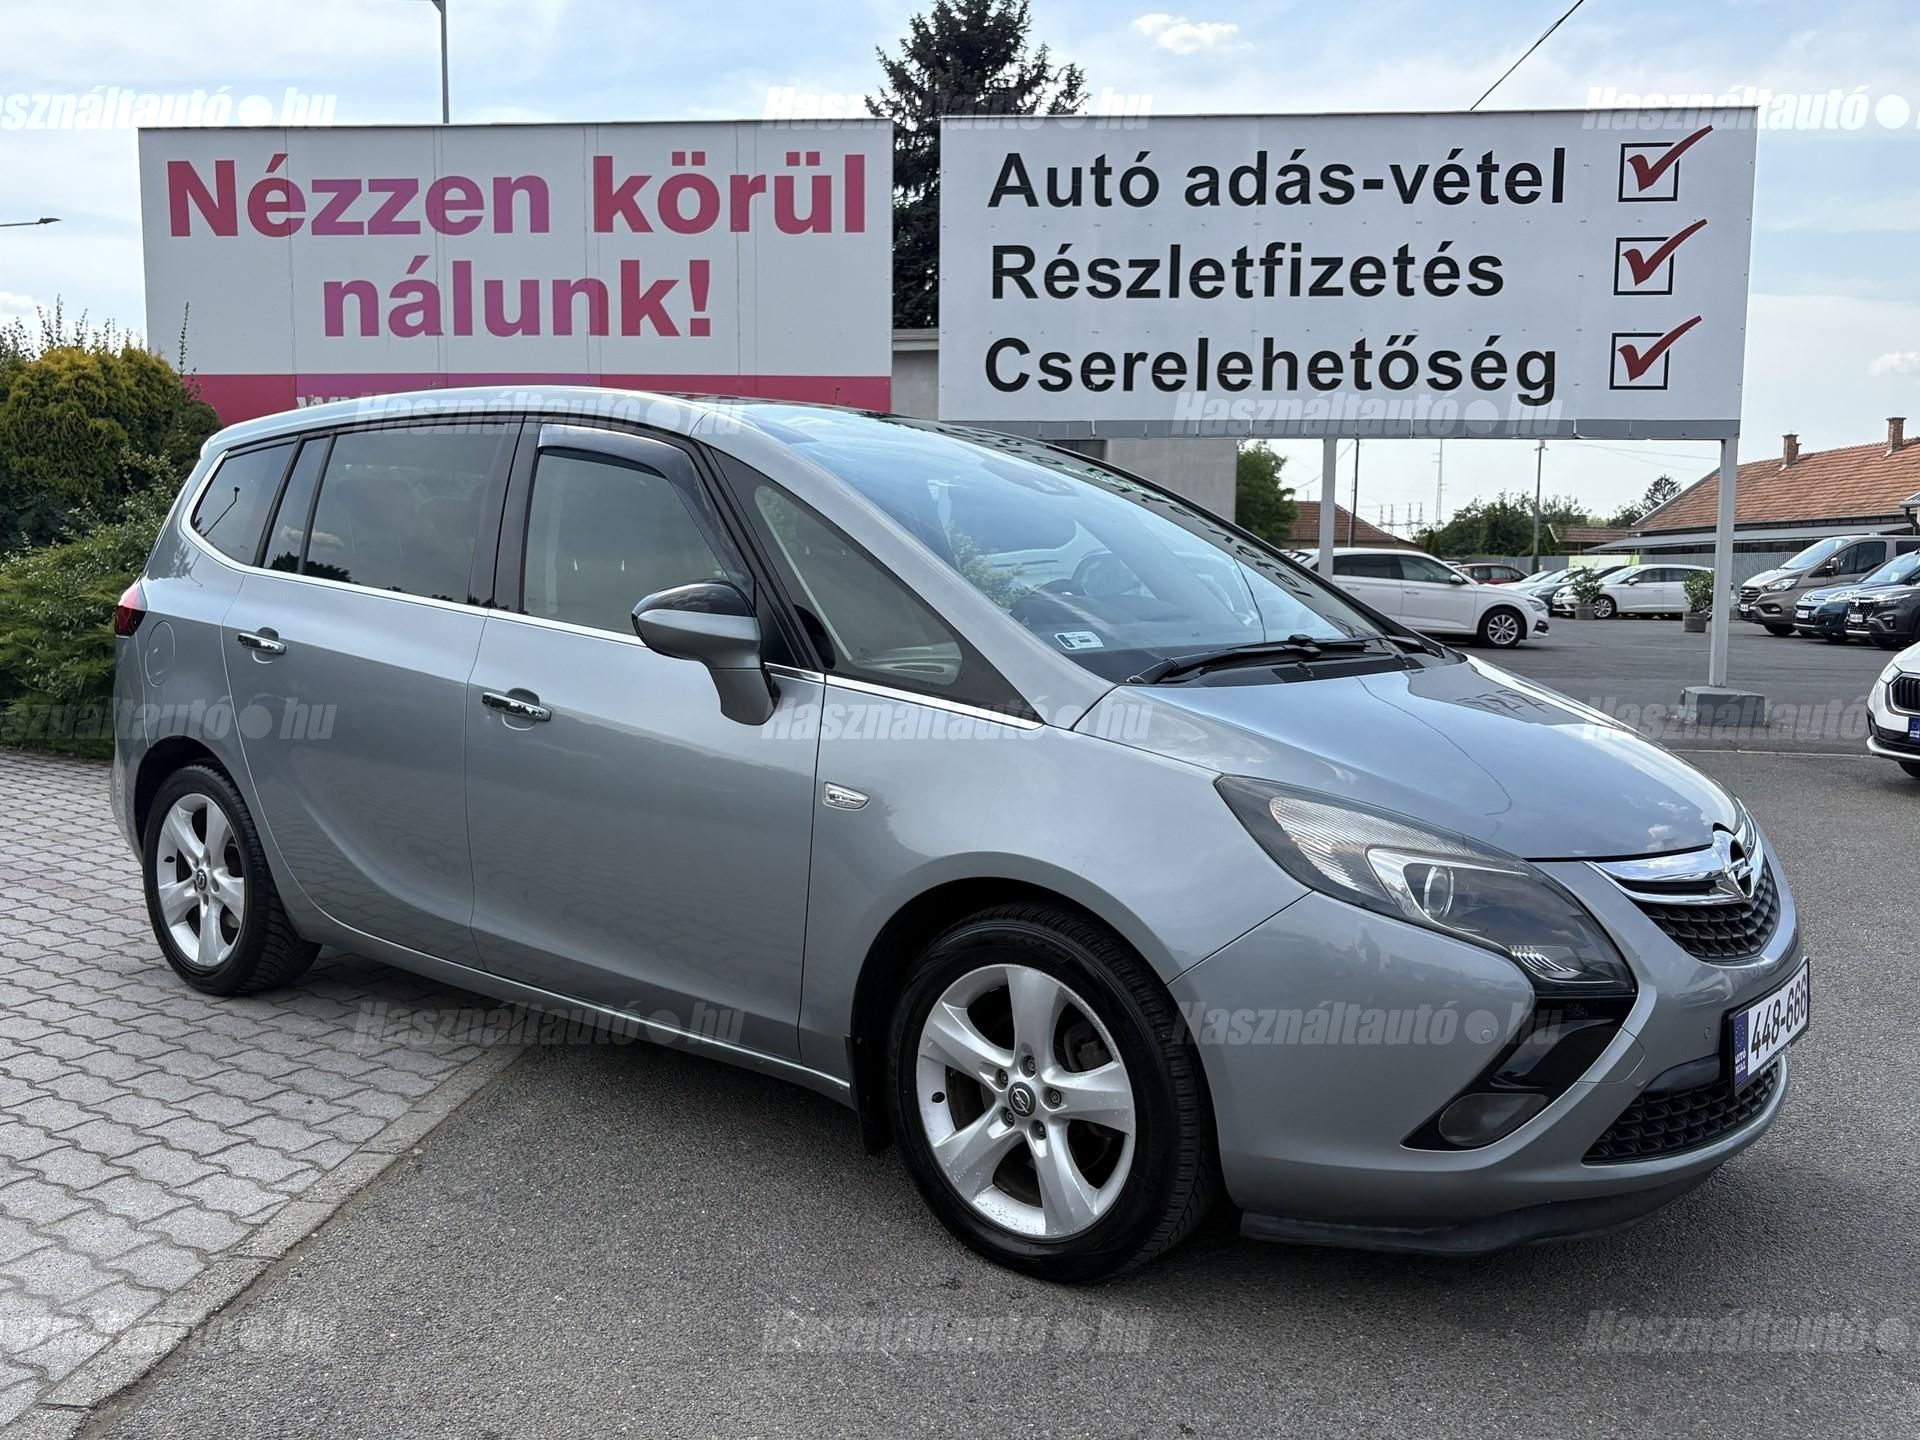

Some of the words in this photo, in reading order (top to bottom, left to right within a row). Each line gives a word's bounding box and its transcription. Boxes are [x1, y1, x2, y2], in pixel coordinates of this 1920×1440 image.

[168, 153, 549, 237] Nézzen
[594, 151, 865, 234] körül
[987, 151, 1160, 208] Autó
[1184, 147, 1566, 207] adás-vétel
[324, 255, 711, 338] nálunk!
[992, 240, 1505, 299] Részletfizetés
[984, 334, 1558, 407] Cserelehetőség
[1751, 974, 1807, 1060] 448-666
